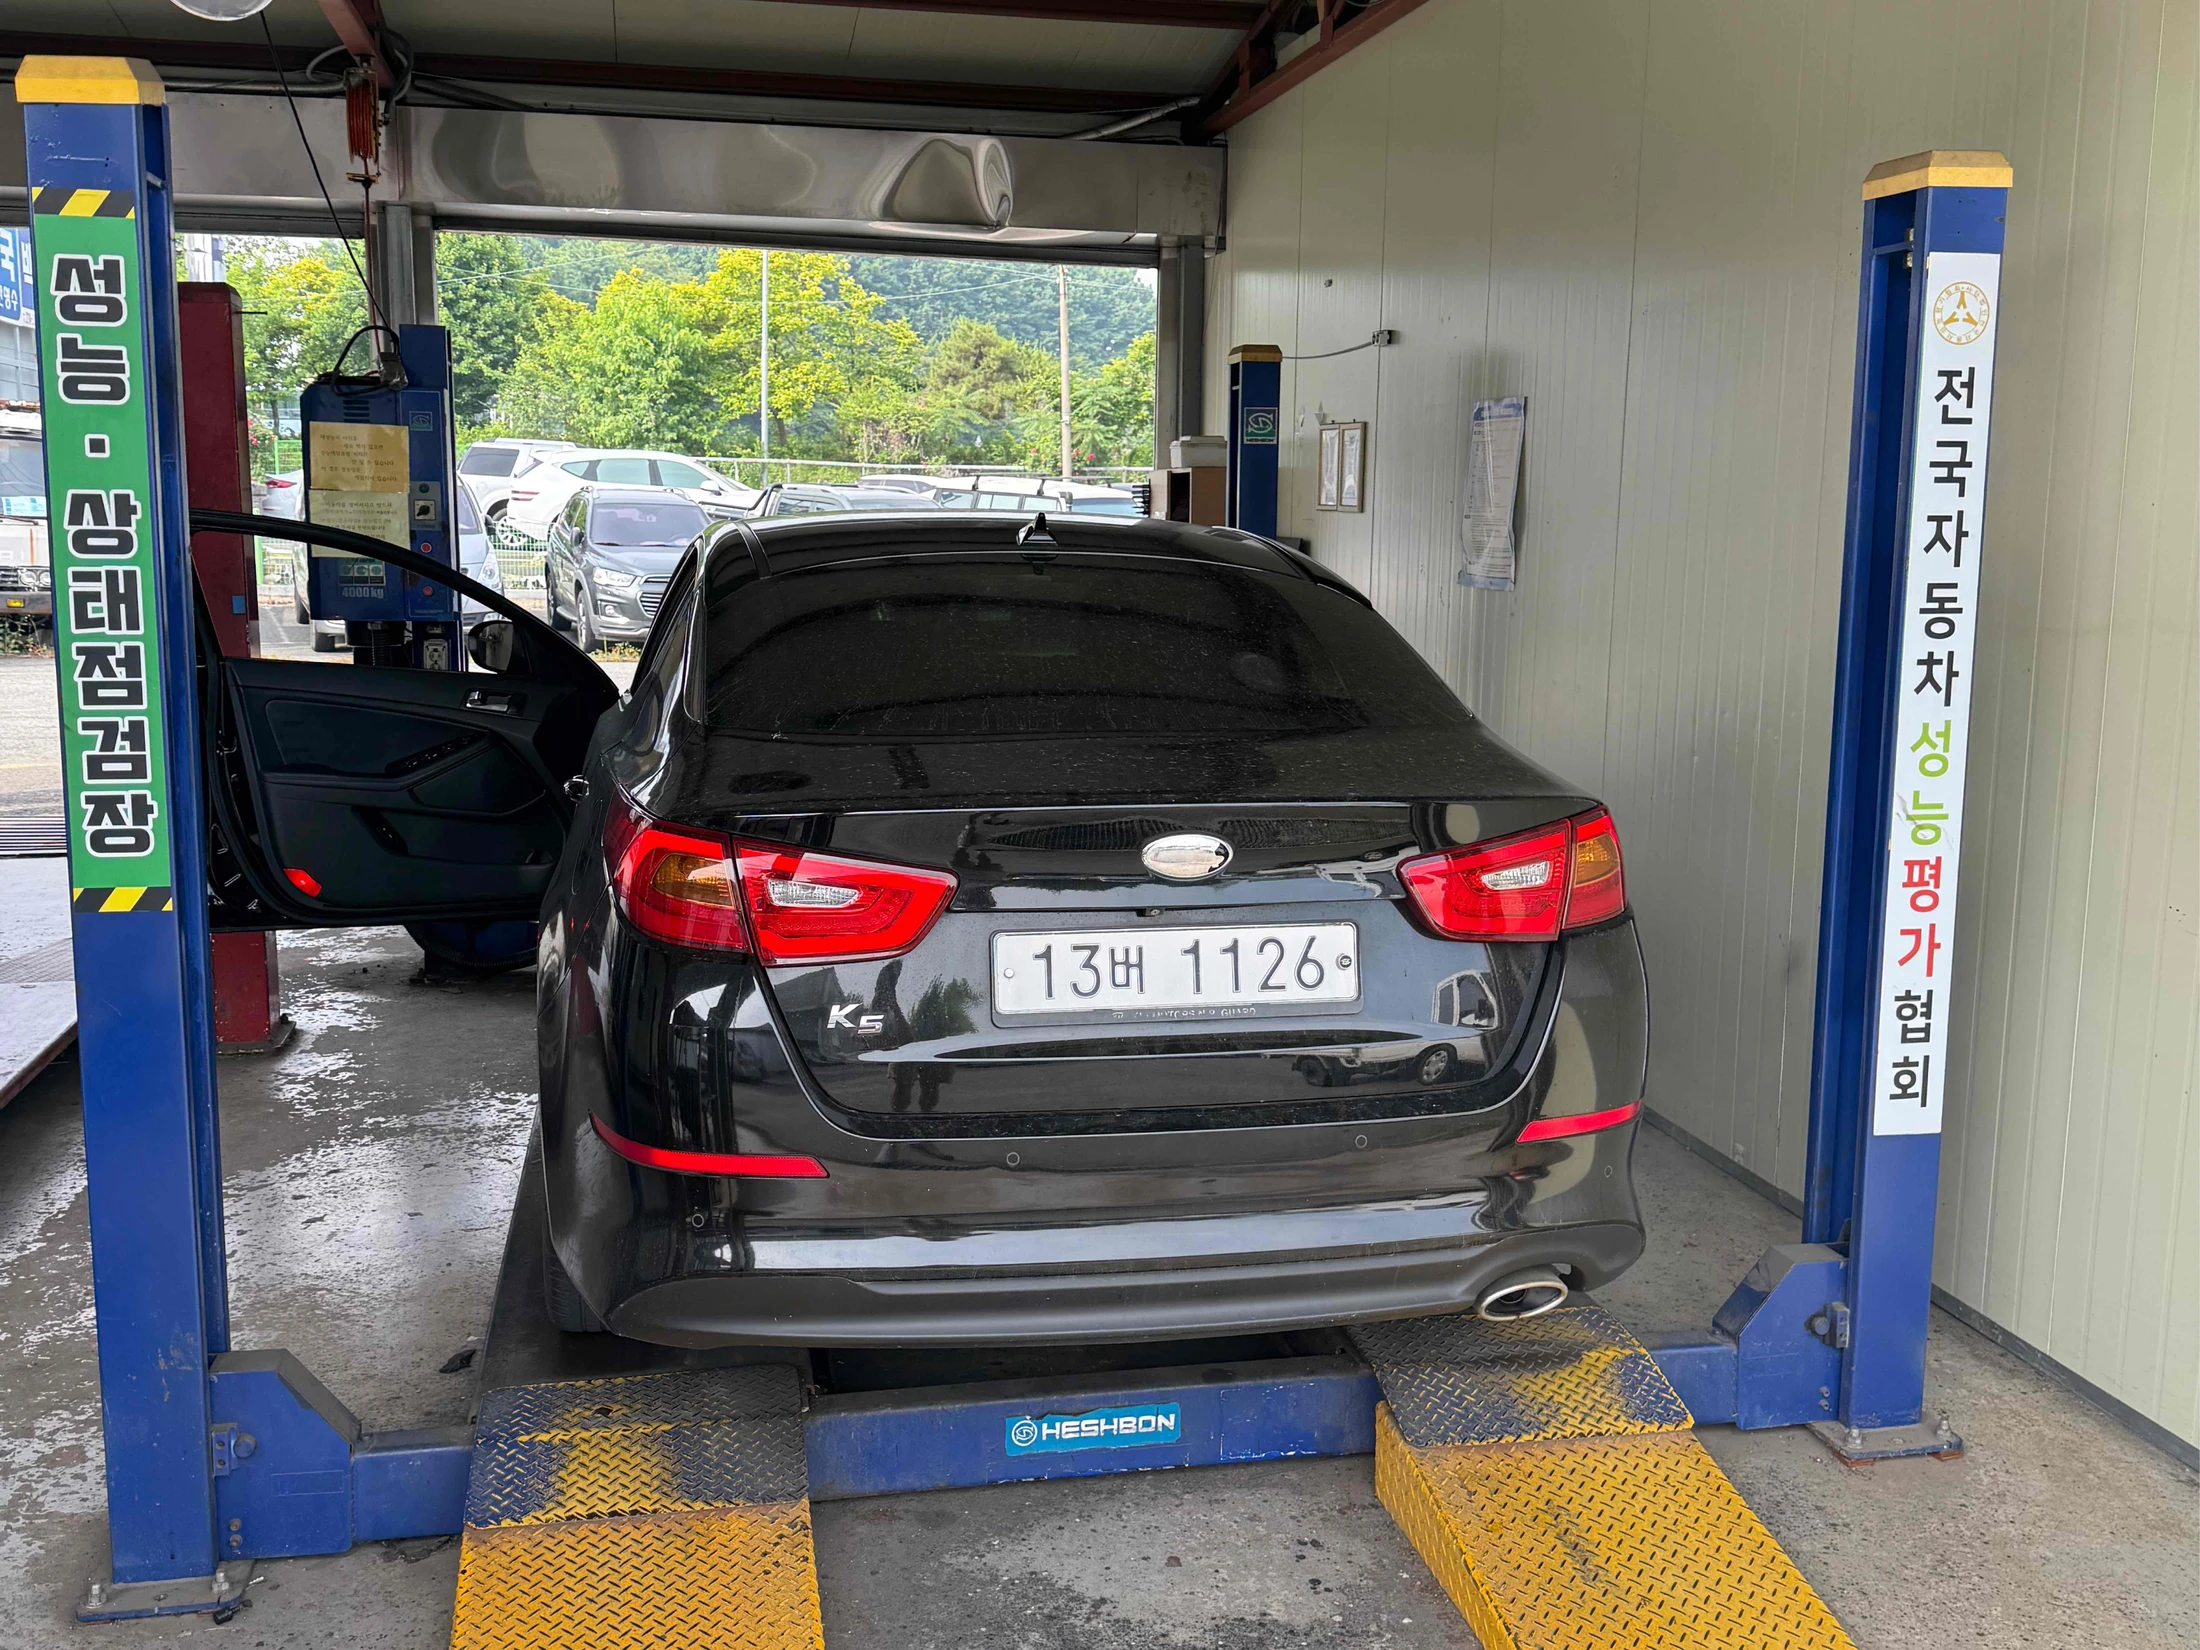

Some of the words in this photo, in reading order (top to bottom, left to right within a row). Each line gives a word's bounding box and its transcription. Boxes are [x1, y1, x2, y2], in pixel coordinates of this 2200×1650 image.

[1889, 366, 1975, 1108] 전국자동차성능평가협회
[1032, 943, 1146, 1000] 13버
[1180, 936, 1325, 995] 1126
[826, 1002, 885, 1035] K5
[1041, 1413, 1176, 1441] HESHBON
